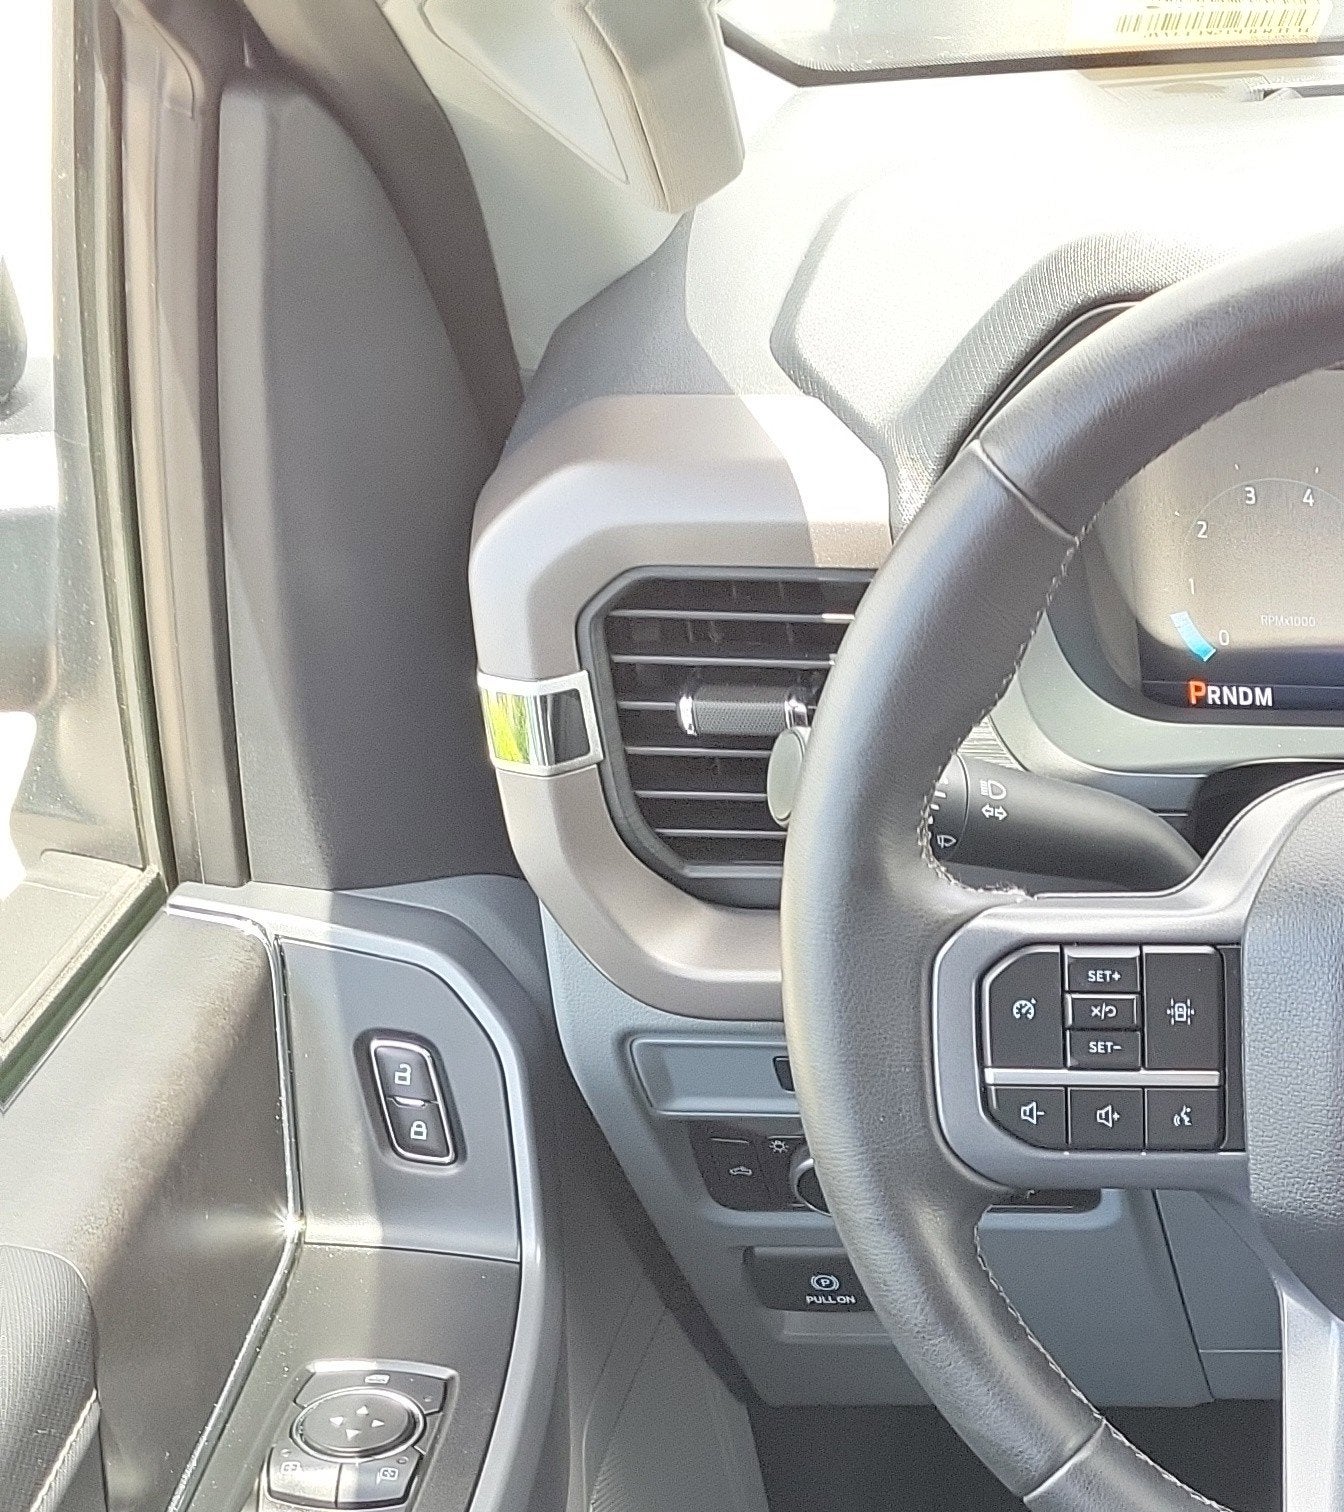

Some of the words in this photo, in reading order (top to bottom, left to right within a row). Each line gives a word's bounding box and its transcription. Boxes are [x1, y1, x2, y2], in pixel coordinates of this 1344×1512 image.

[1244, 487, 1256, 504] 3
[1303, 489, 1314, 506] 4
[1197, 521, 1208, 538] 2
[1188, 578, 1195, 595] 1
[1219, 630, 1230, 646] 0
[1088, 970, 1121, 982] SET+
[806, 1295, 835, 1304] PULL
[837, 1295, 856, 1304] ON
